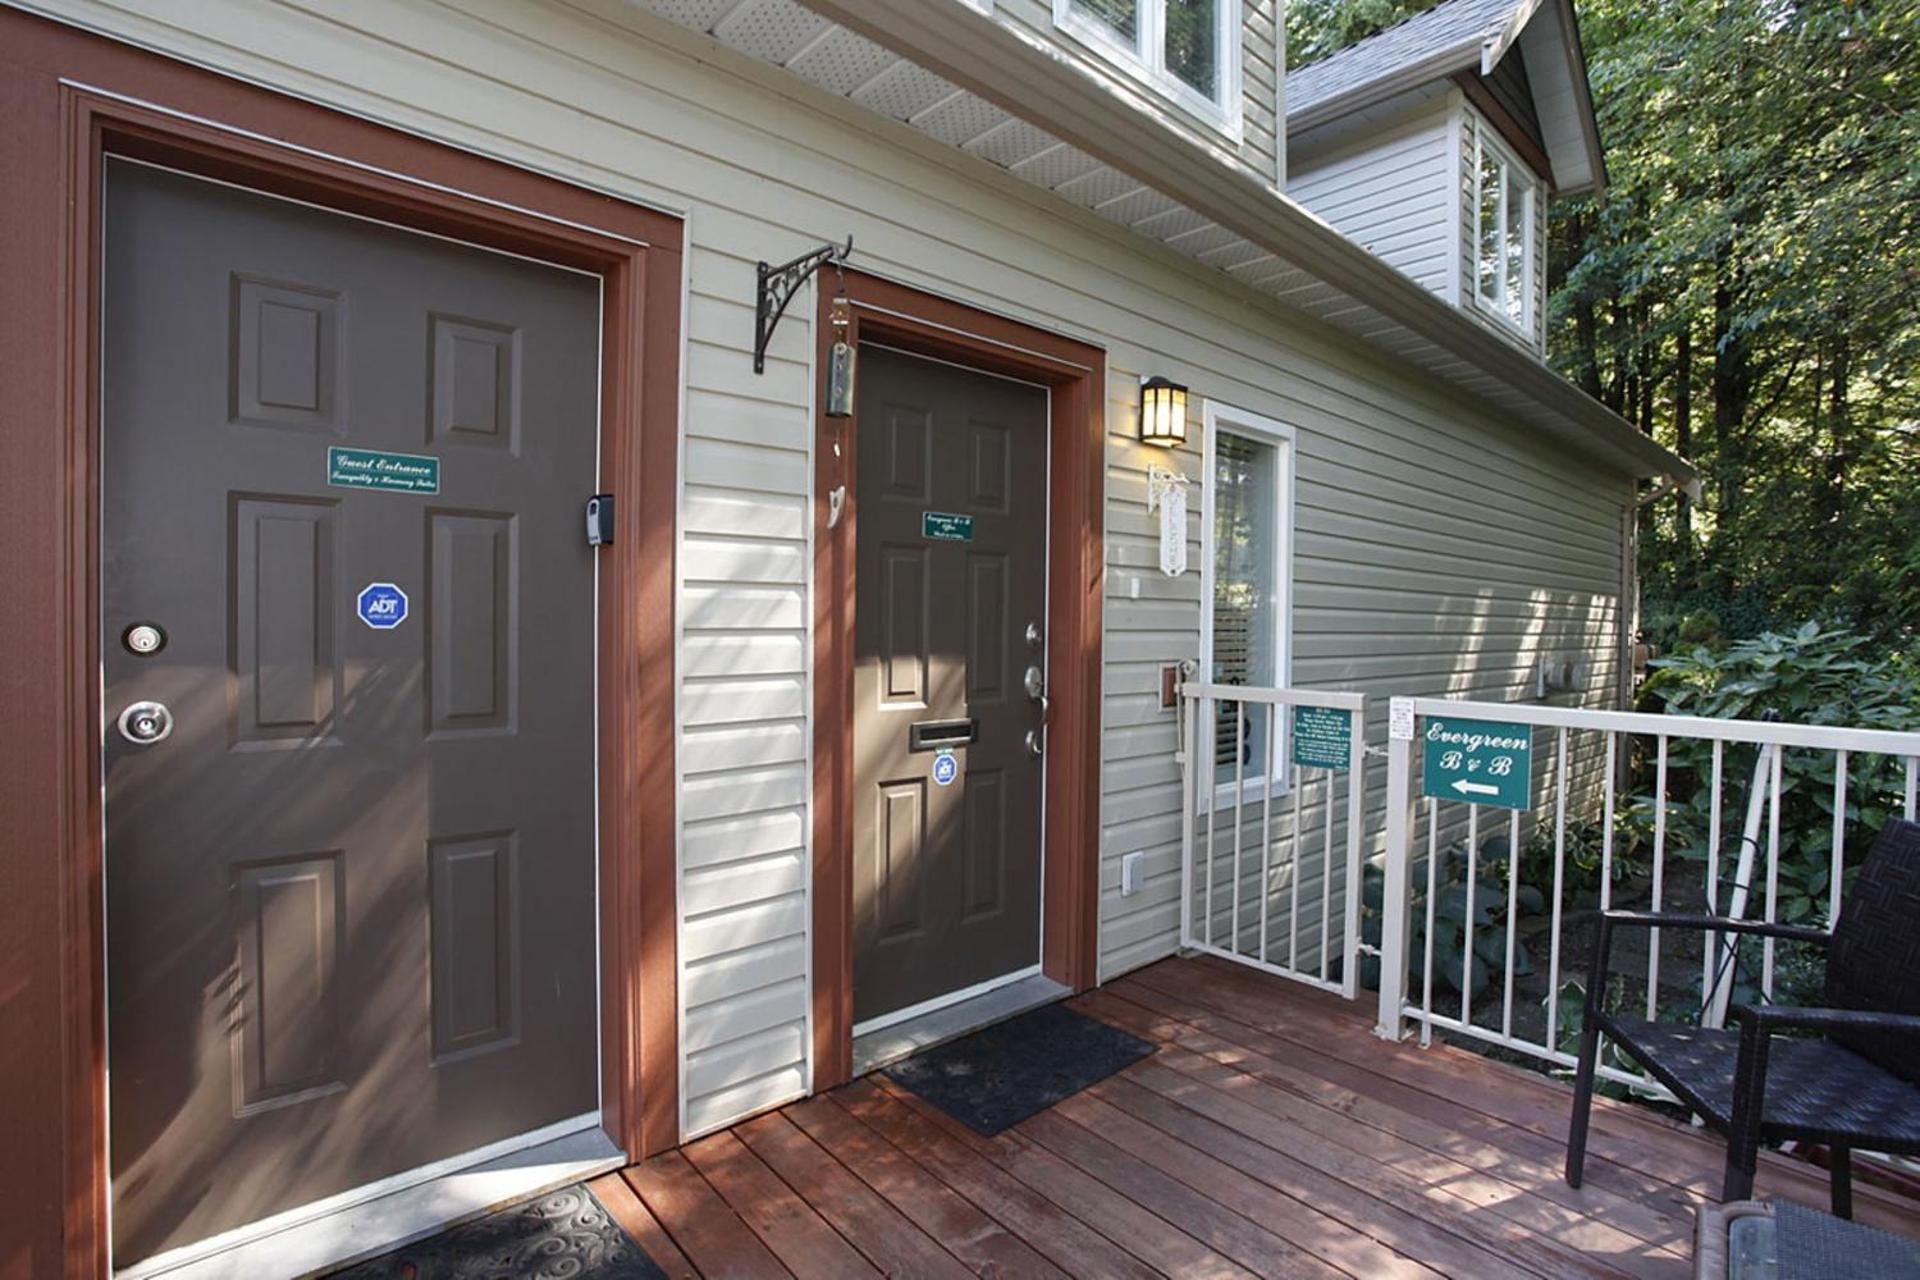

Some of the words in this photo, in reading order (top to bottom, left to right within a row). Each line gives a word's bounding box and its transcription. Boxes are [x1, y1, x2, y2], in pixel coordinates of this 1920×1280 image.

[336, 455, 375, 470] Guest
[376, 459, 431, 475] Entrance
[368, 600, 398, 614] ADT
[1426, 722, 1529, 753] Evergreen
[1439, 750, 1463, 770] B
[1467, 758, 1481, 773] &
[1488, 756, 1513, 777] B
